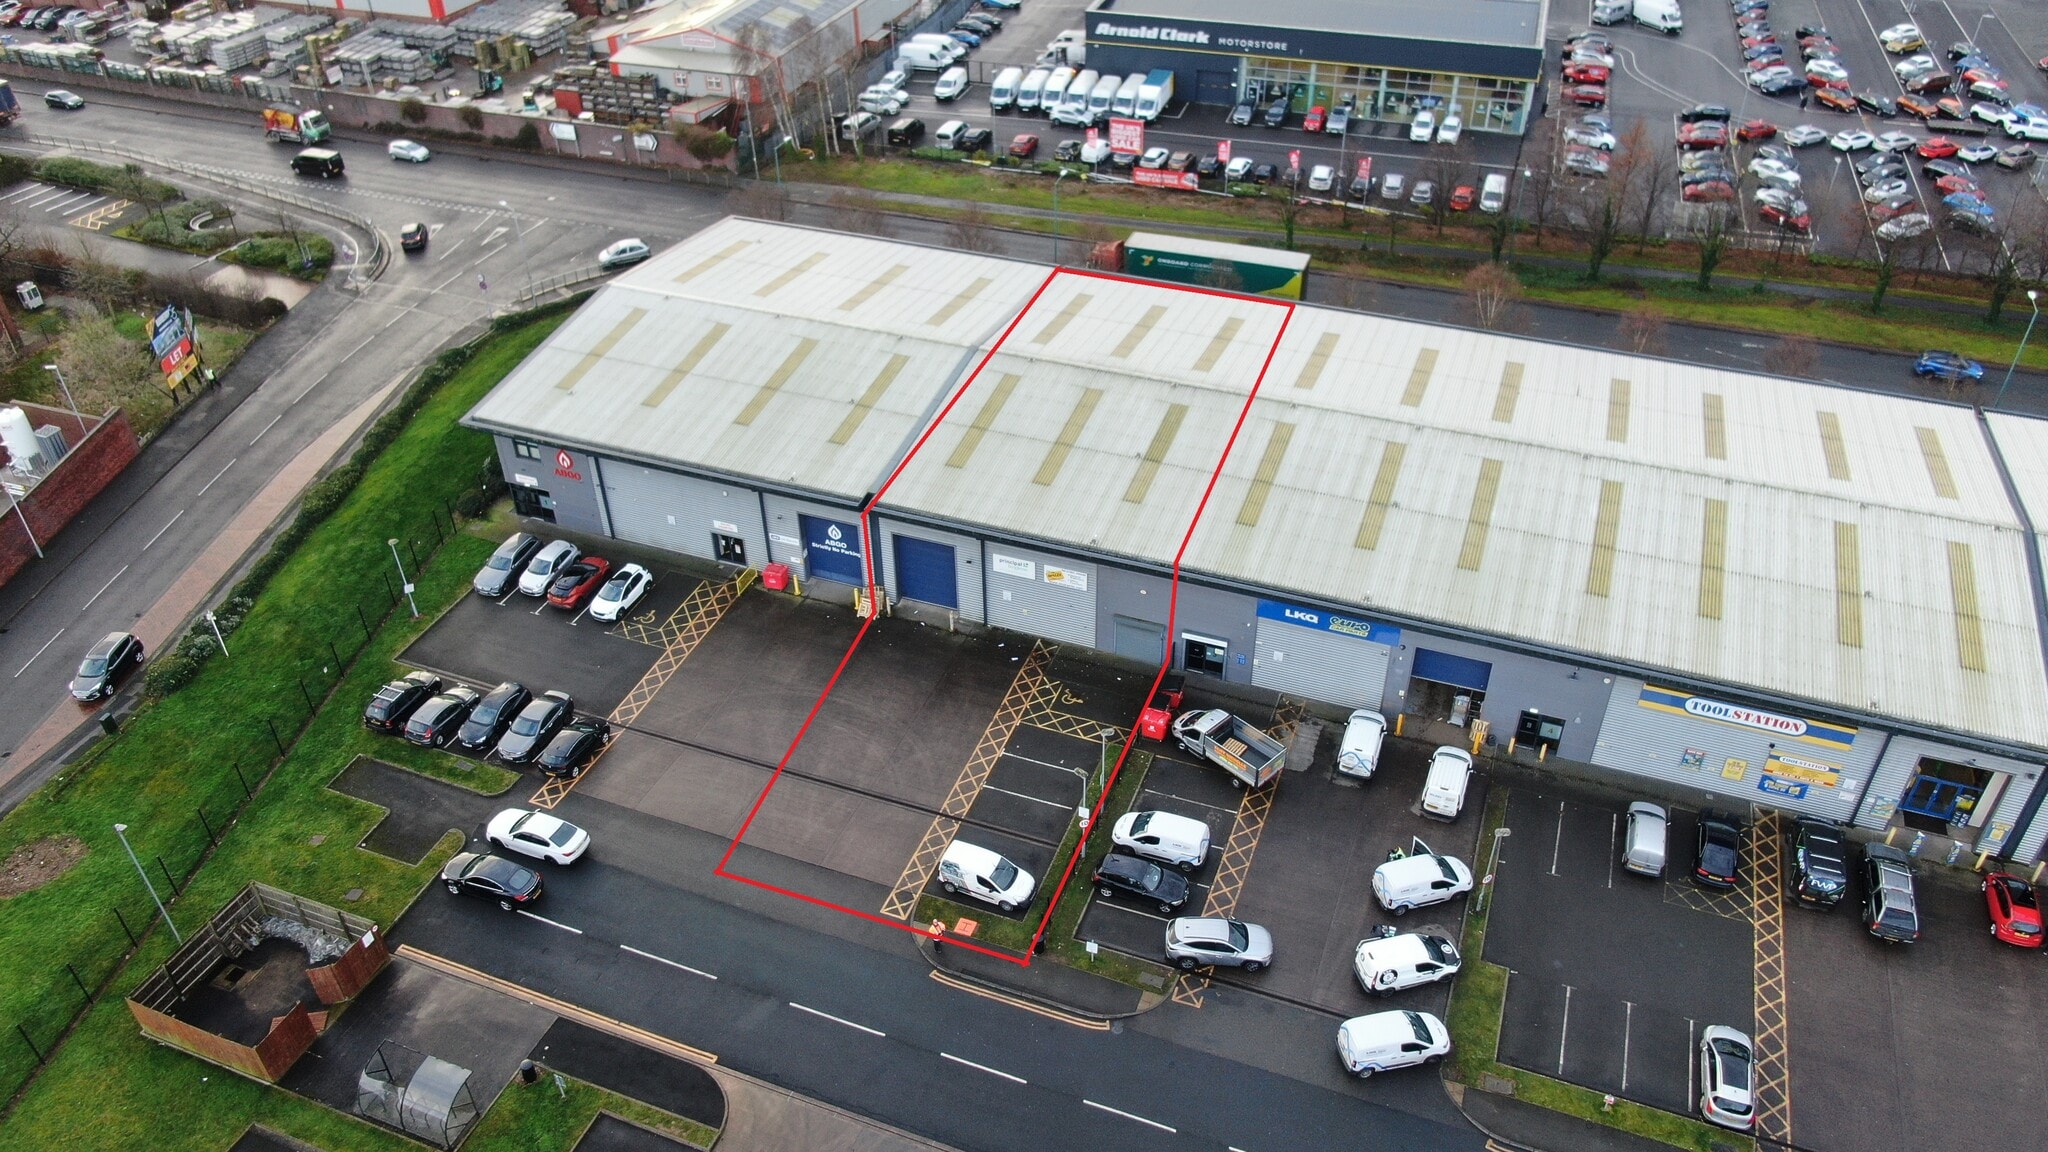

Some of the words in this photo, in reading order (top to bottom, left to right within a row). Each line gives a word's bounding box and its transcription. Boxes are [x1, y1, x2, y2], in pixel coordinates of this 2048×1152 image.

[1095, 22, 1158, 40] Arnold
[1159, 27, 1210, 44] Clark
[1218, 37, 1288, 51] MOTORSTORE
[1111, 140, 1140, 150] SALE
[169, 346, 183, 366] LET
[555, 468, 582, 481] ABGO
[811, 542, 831, 551] Strictly
[840, 548, 861, 558] Parking
[825, 539, 847, 549] ABGO
[1285, 608, 1319, 624] LKQ
[1691, 699, 1803, 733] TOOLSTATION
[1781, 757, 1828, 771] TOOLSTATION
